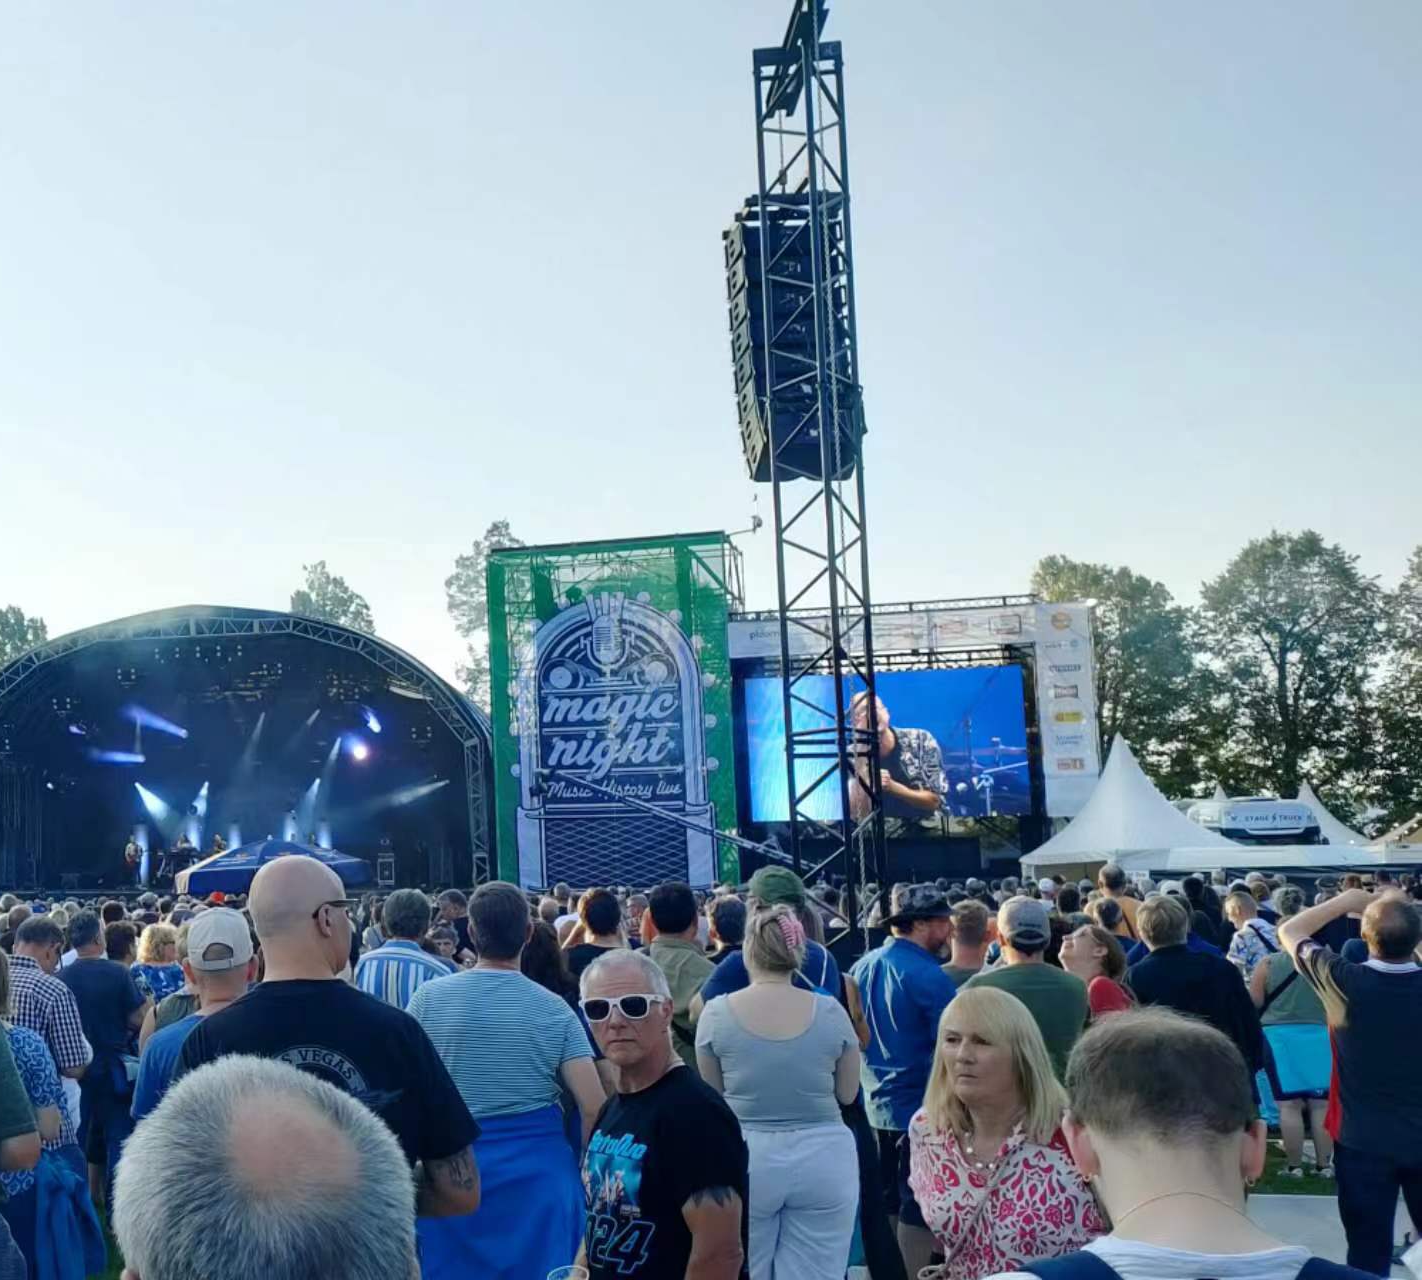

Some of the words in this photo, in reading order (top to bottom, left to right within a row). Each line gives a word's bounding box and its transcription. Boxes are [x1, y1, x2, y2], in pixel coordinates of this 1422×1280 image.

[542, 692, 679, 738] magic
[548, 721, 676, 781] night
[546, 780, 594, 798] Music
[599, 778, 654, 799] History
[656, 779, 683, 795] live
[297, 1048, 357, 1080] VEGAS
